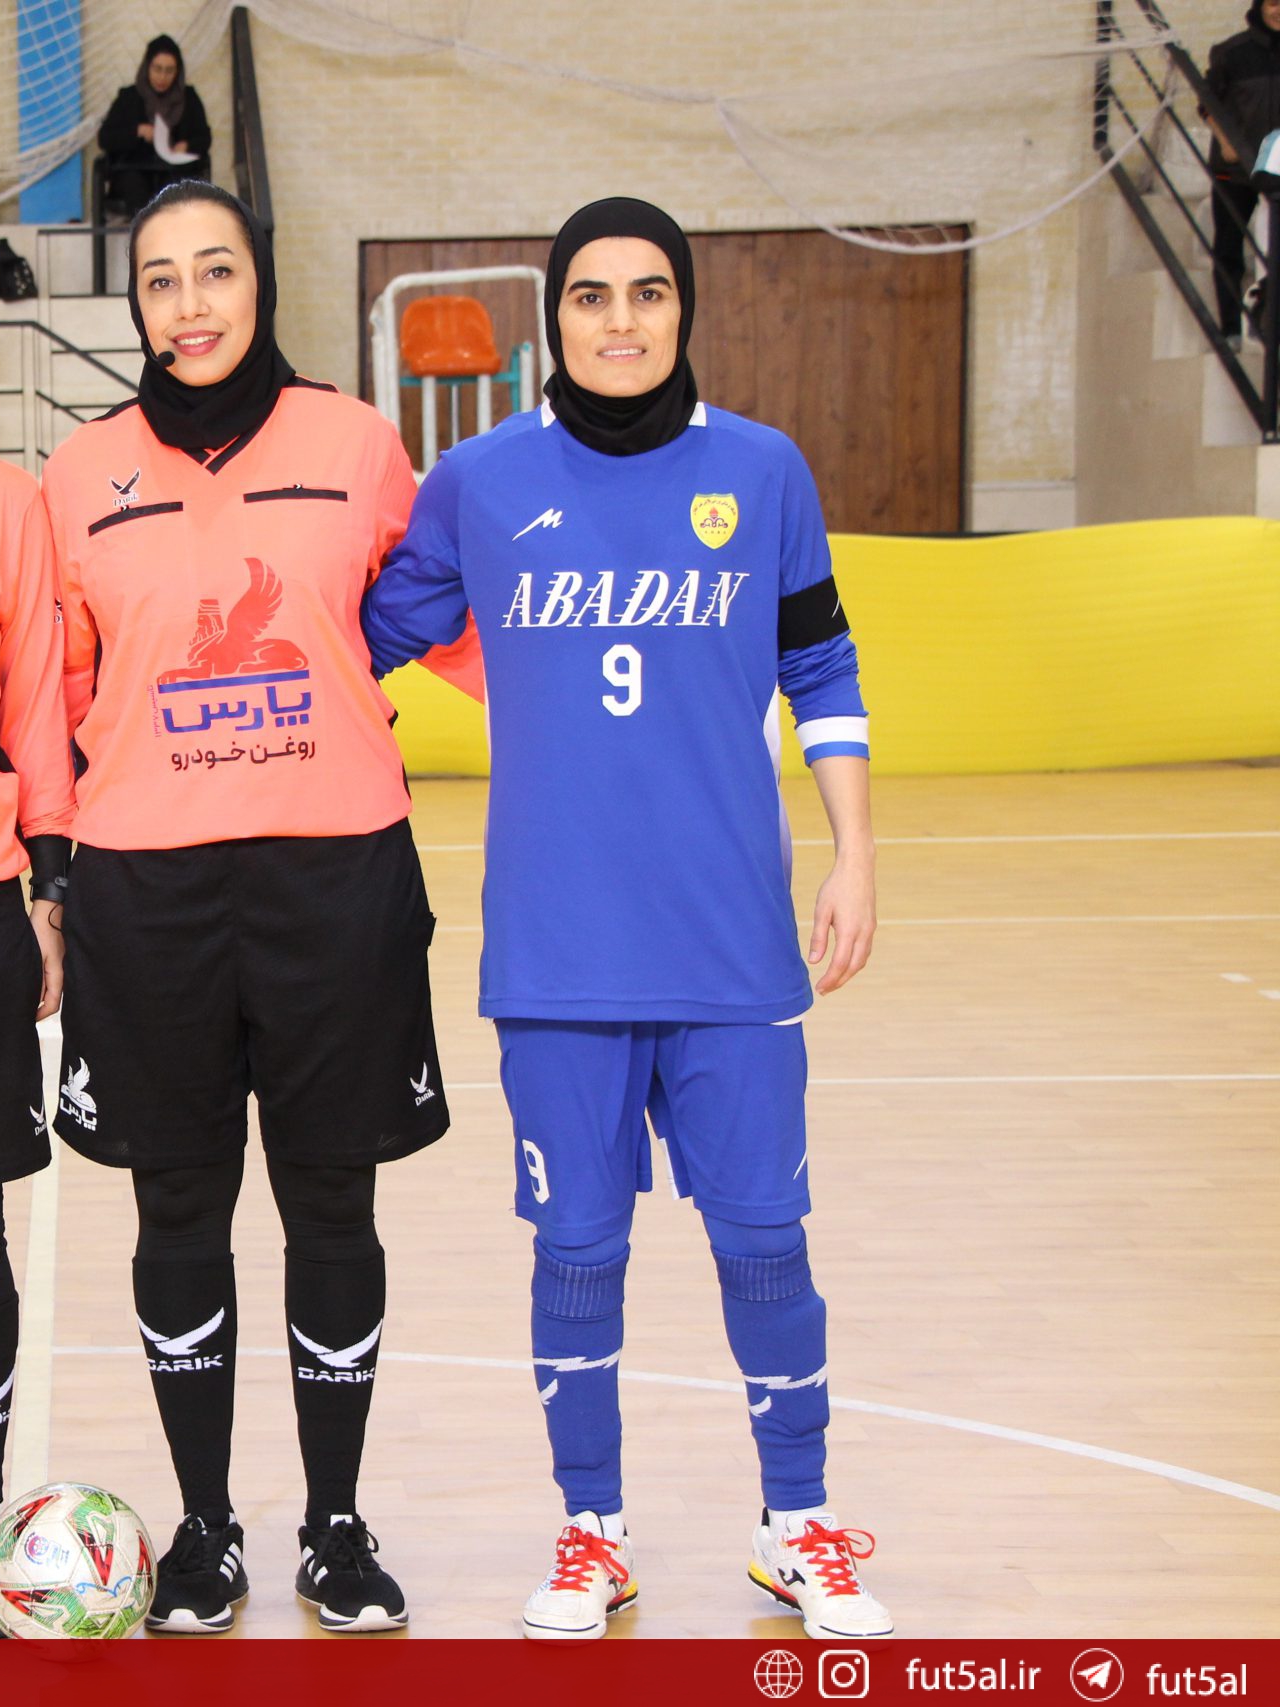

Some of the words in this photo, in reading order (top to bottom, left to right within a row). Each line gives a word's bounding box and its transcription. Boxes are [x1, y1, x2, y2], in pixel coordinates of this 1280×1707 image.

[501, 570, 750, 628] ABADAN
[602, 643, 642, 717] 9
[161, 685, 312, 734] پارس
[170, 740, 246, 771] خودرو
[250, 735, 316, 764] روغن
[522, 1139, 550, 1204] 9
